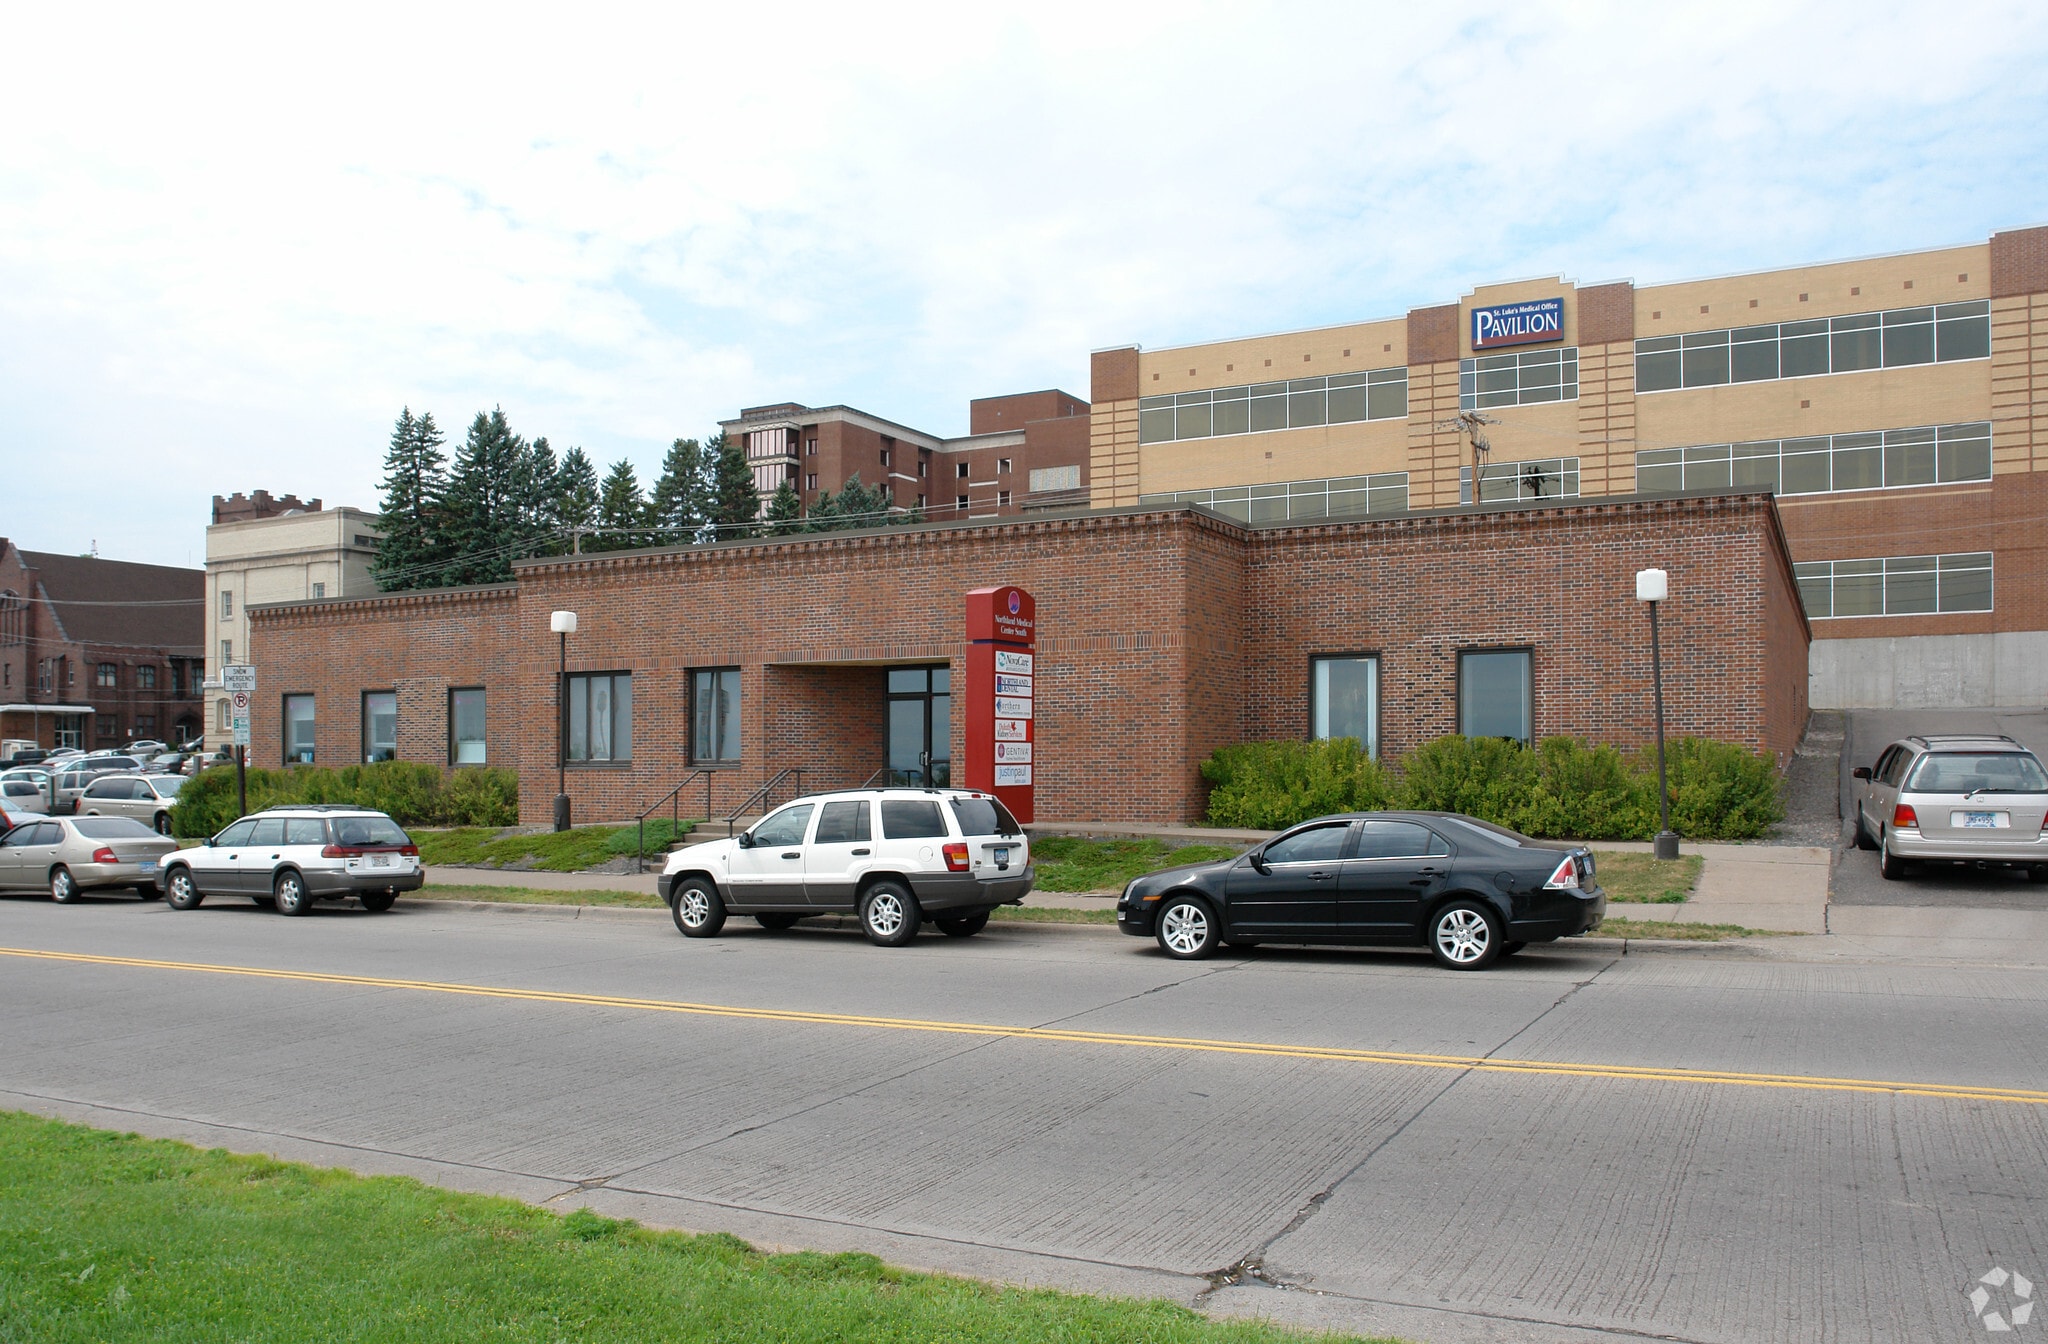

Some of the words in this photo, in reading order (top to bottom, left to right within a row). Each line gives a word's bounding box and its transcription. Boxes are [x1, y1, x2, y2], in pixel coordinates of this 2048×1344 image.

[1493, 309, 1501, 317] St.
[1502, 307, 1518, 316] Luke's
[1519, 304, 1540, 314] Medical
[1541, 302, 1558, 311] Office
[1006, 747, 1029, 756] GENTIVA
